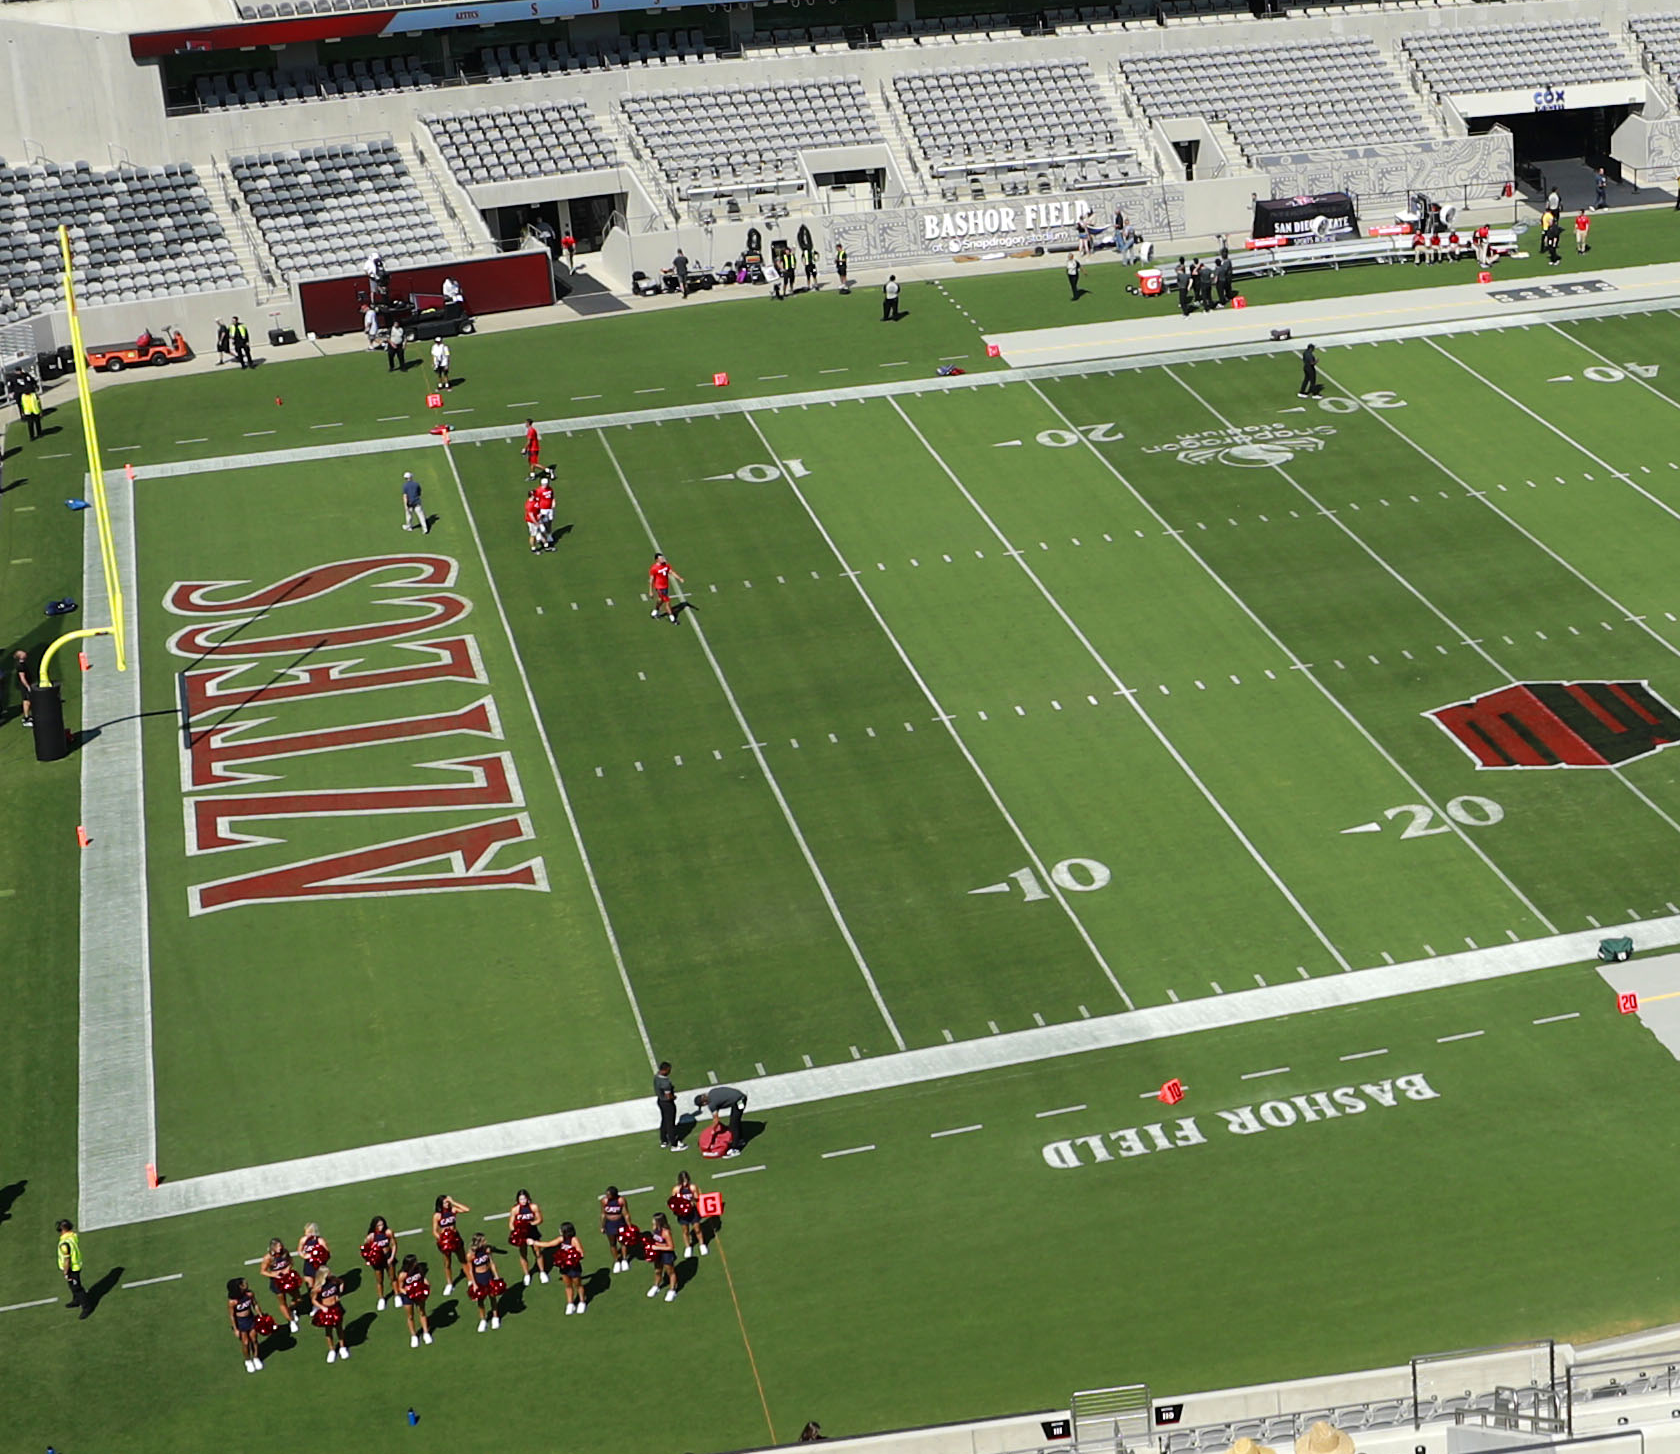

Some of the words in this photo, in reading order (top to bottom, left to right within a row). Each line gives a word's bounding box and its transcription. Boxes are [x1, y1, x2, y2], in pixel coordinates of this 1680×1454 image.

[1533, 90, 1565, 104] COX
[923, 207, 1017, 240] BASHOR
[1024, 200, 1090, 230] FIELD
[1274, 222, 1293, 234] SAN
[963, 236, 1025, 251] Snapdragon
[1027, 231, 1068, 244] stadium
[1147, 278, 1158, 289] G
[1582, 362, 1662, 384] 40
[1317, 391, 1408, 414] 30
[1035, 422, 1125, 448] 20
[1143, 424, 1337, 454] Snapdragon
[1176, 420, 1286, 441] stadium
[734, 458, 812, 484] 10
[162, 551, 549, 917] AZTECS
[1383, 794, 1505, 841] 20
[1010, 857, 1112, 902] 10
[1622, 994, 1637, 1009] 20
[1167, 1082, 1181, 1098] 10
[1213, 1070, 1441, 1139] BASHOR
[1041, 1115, 1208, 1173] FIELD
[703, 1196, 717, 1214] G
